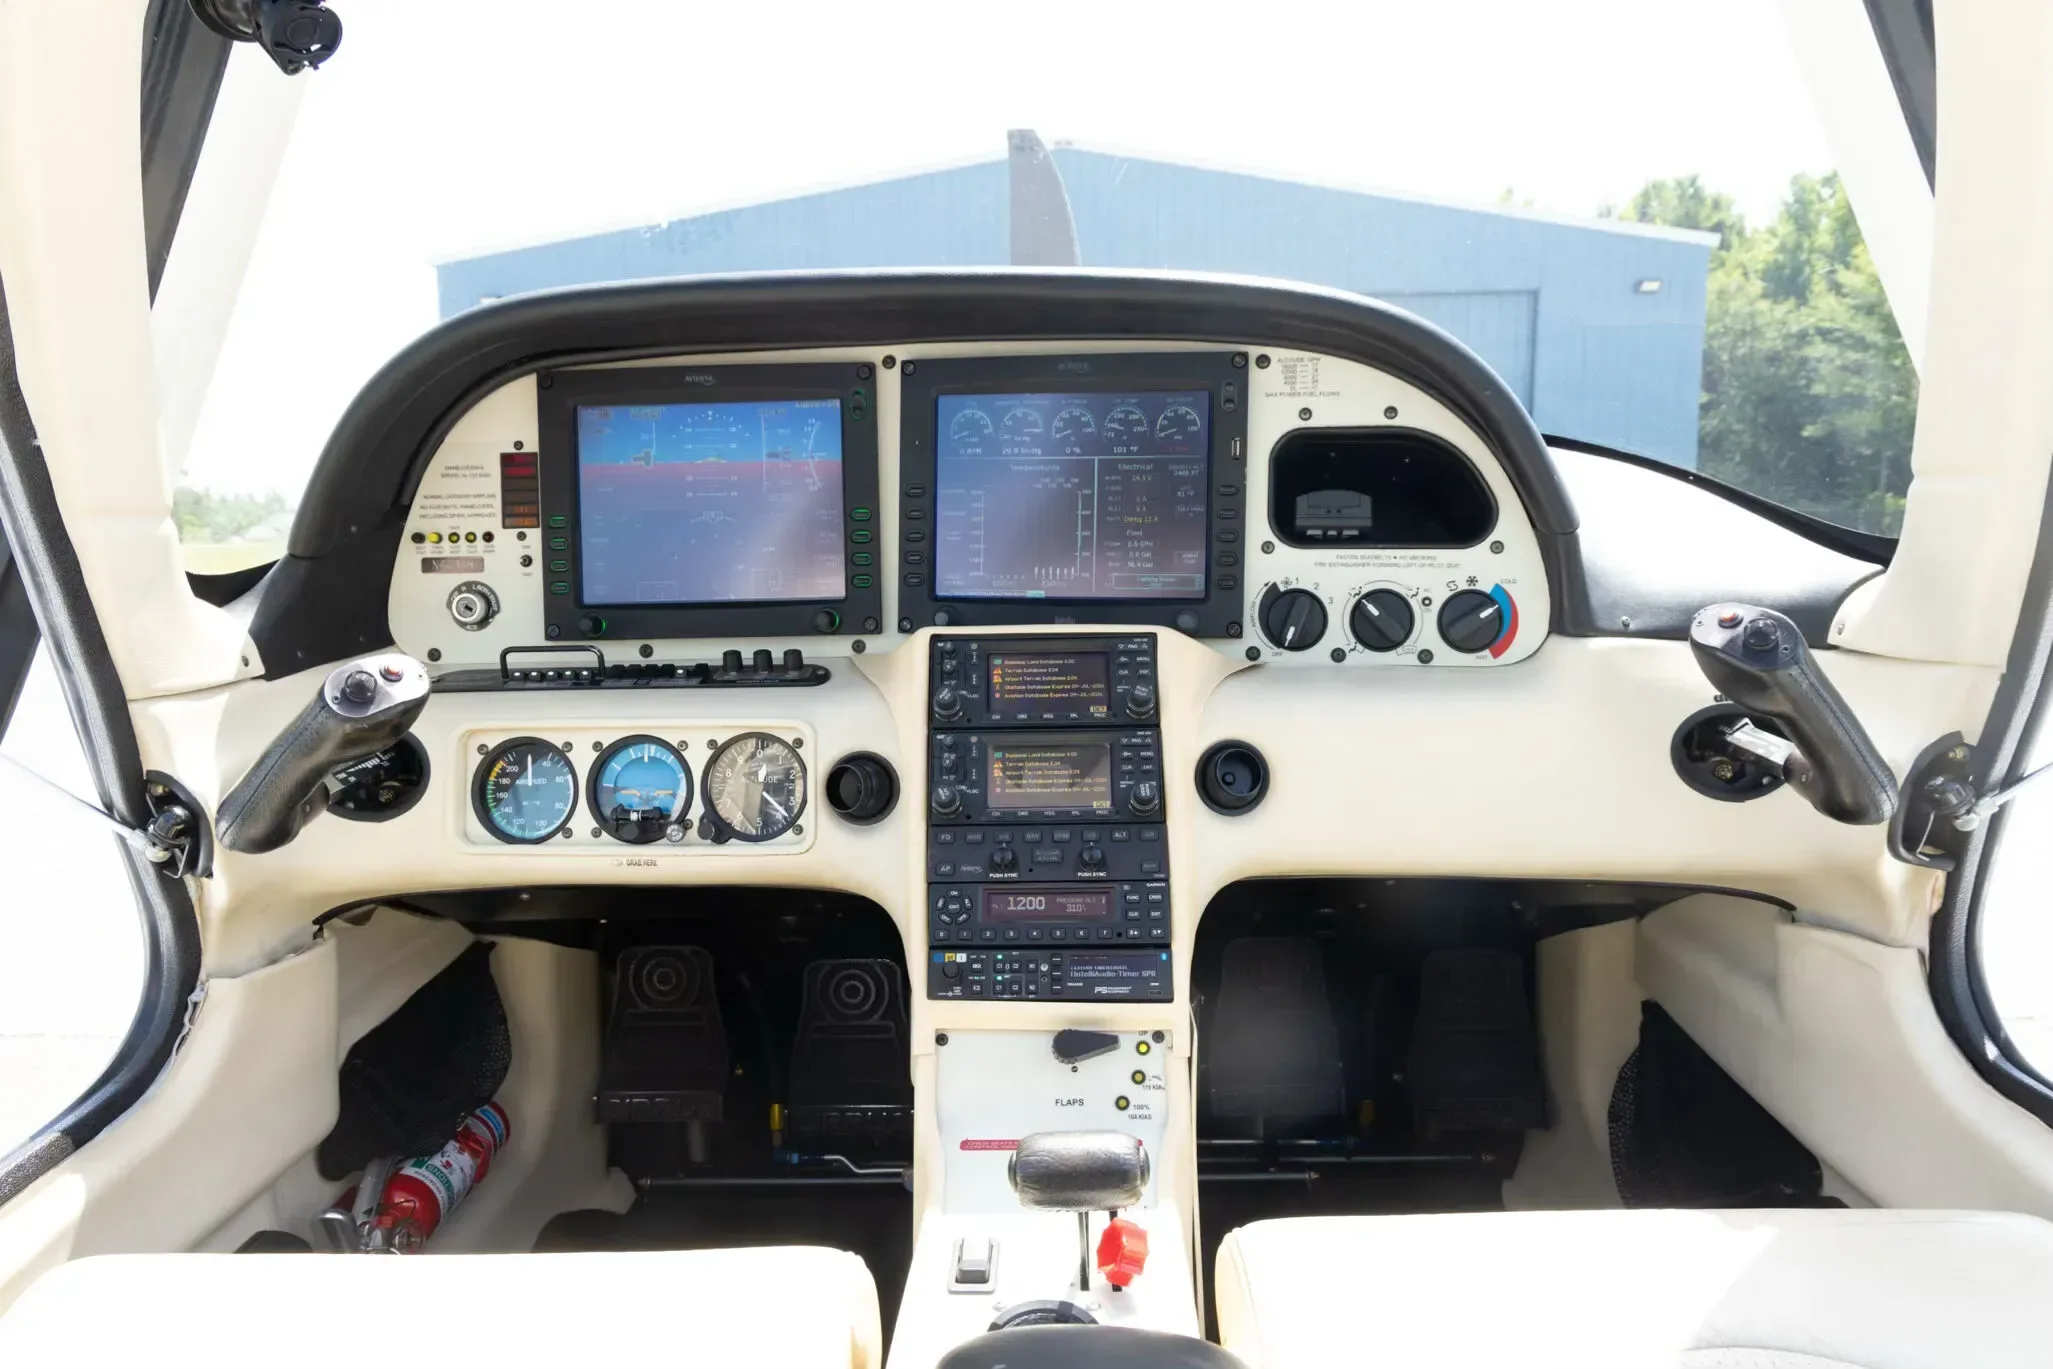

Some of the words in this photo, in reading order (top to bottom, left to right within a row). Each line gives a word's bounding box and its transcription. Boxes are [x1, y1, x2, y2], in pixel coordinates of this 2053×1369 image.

[1313, 582, 1319, 590] 2
[757, 749, 763, 758] 0
[726, 768, 732, 777] 8
[789, 769, 796, 779] 2
[789, 796, 795, 805] 3
[757, 818, 763, 827] 5
[1007, 896, 1045, 910] 1200
[1055, 1098, 1085, 1107] FLAPS
